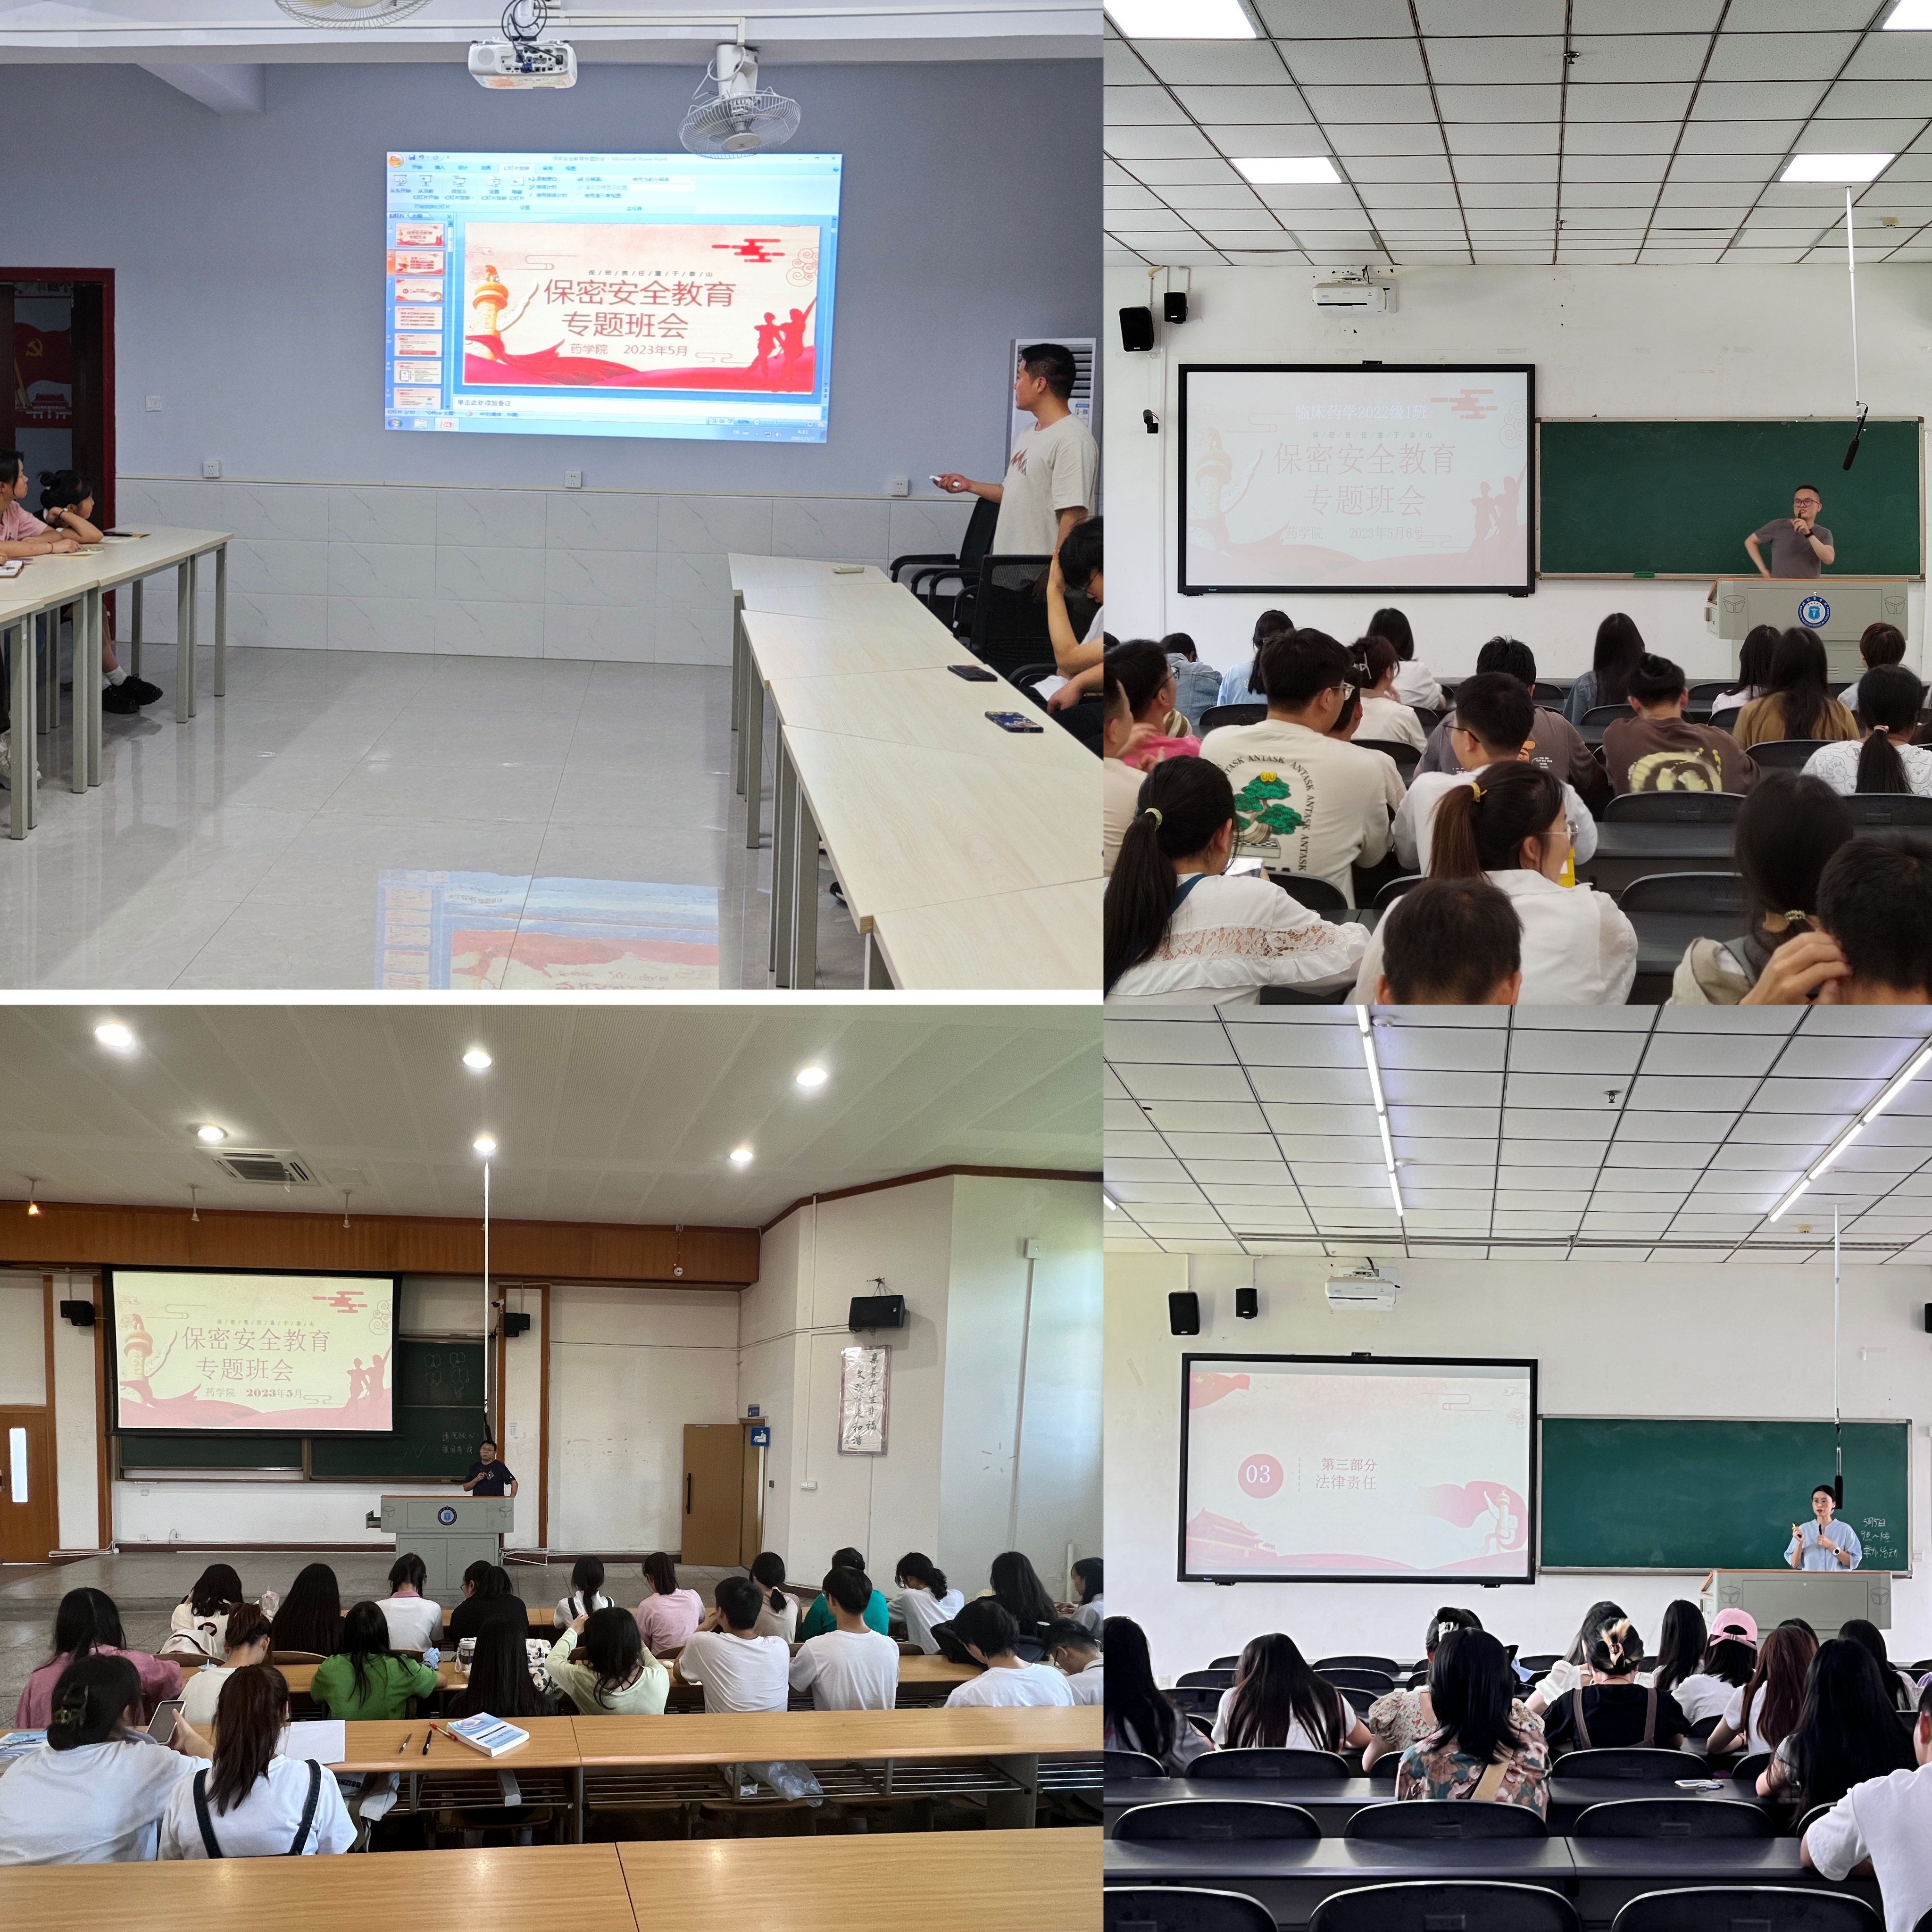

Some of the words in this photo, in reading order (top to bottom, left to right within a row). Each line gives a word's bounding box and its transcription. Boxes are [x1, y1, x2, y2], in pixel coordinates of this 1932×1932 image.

[544, 279, 737, 307] 保密安全教育
[561, 311, 689, 339] 专题班会
[570, 343, 608, 355] 药学院
[623, 344, 688, 356] 2023年5月
[1295, 404, 1428, 420] 临床药学2022级1班
[1273, 442, 1456, 475] 保密安全教育
[1304, 483, 1426, 516] 专题班会
[1285, 526, 1323, 540] 药学院
[1349, 526, 1424, 540] 2023年5月6号
[1225, 757, 1245, 776] TASK
[1248, 755, 1285, 764] ANTASK
[1290, 761, 1315, 791] ANTASK
[1302, 794, 1315, 830] ANTASK
[1298, 833, 1309, 872] ANTASK
[181, 1326, 331, 1353] 保密安全教育
[195, 1357, 294, 1382] 专题班会
[205, 1387, 236, 1397] 药学院
[246, 1388, 302, 1398] 2023年5月
[1321, 1457, 1377, 1472] 第三部分
[1245, 1465, 1271, 1484] 03
[1316, 1474, 1377, 1491] 法律责任
[1863, 1517, 1885, 1527] 5月5日
